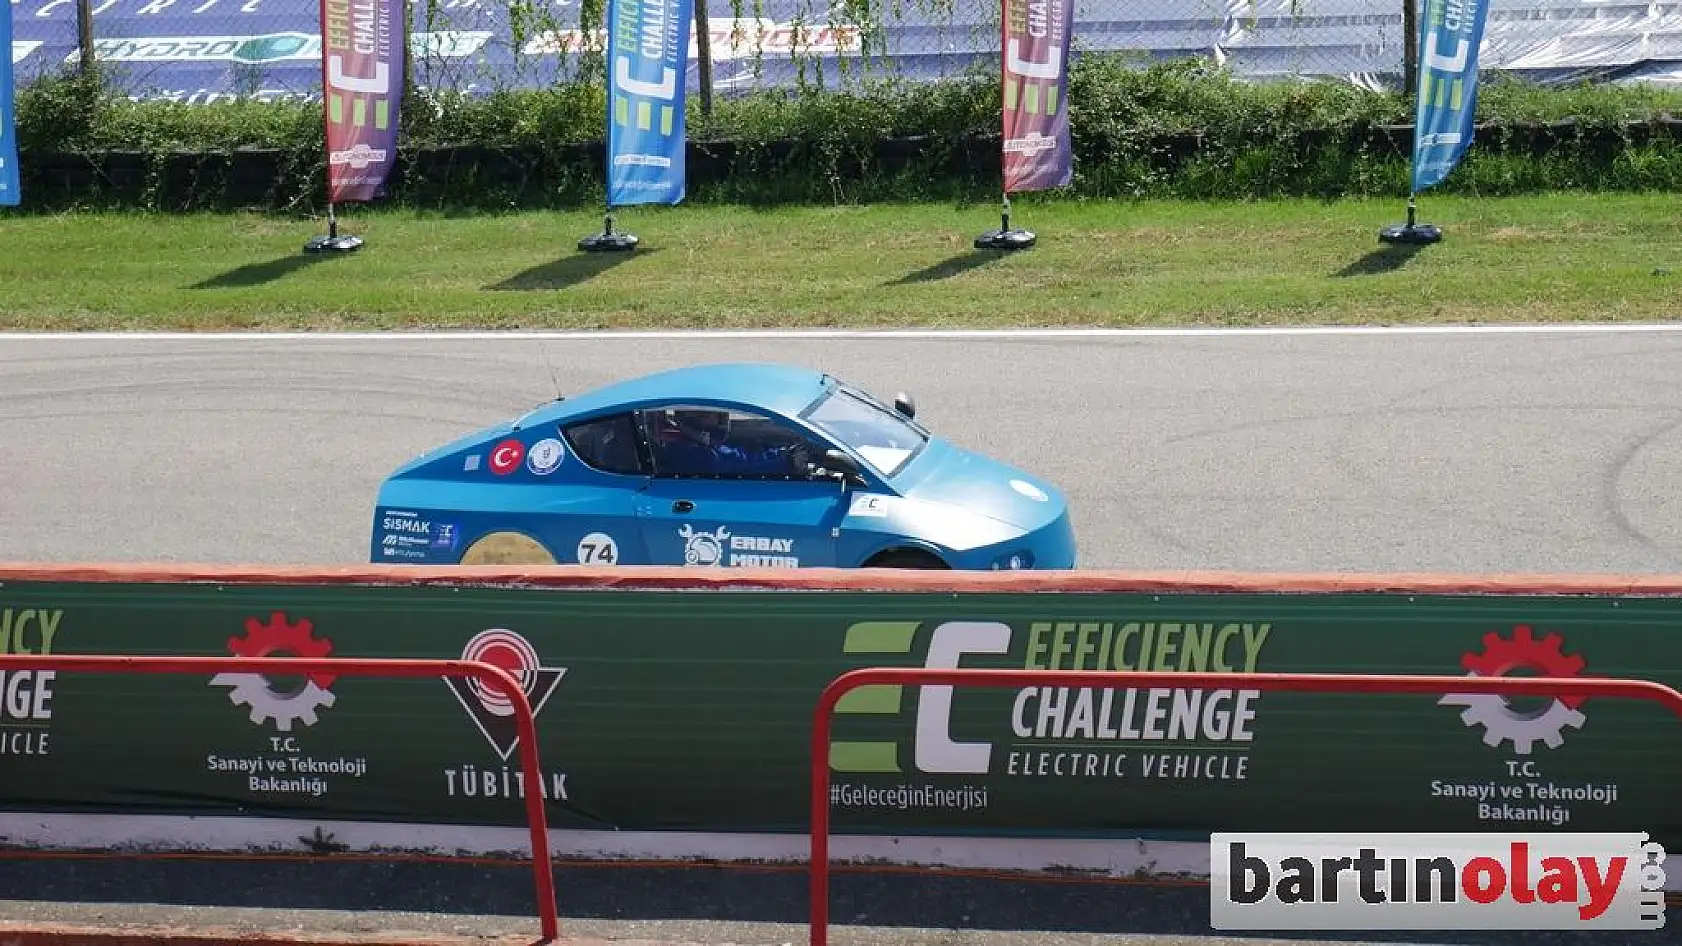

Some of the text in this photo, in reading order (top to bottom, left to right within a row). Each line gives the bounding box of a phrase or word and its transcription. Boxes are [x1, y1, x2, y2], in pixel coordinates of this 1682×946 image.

[581, 543, 614, 564] 74
[730, 536, 795, 552] ERBAY
[1024, 622, 1272, 673] EFFICIENCY
[0, 669, 56, 719] GE
[1011, 685, 1261, 743] CHALLENGE
[269, 737, 301, 752] T.C.
[207, 755, 367, 777] Sanayi ve Teknoloji
[1007, 752, 1249, 780] ELECTRIC VEHICLE
[1505, 761, 1542, 778] T.C.
[249, 776, 328, 796] Bakanlığı
[830, 784, 988, 810] #GeleceğinEnerjisi
[1431, 780, 1618, 805] Sanayi ve Teknoloji
[1477, 803, 1570, 826] Bakanlığı
